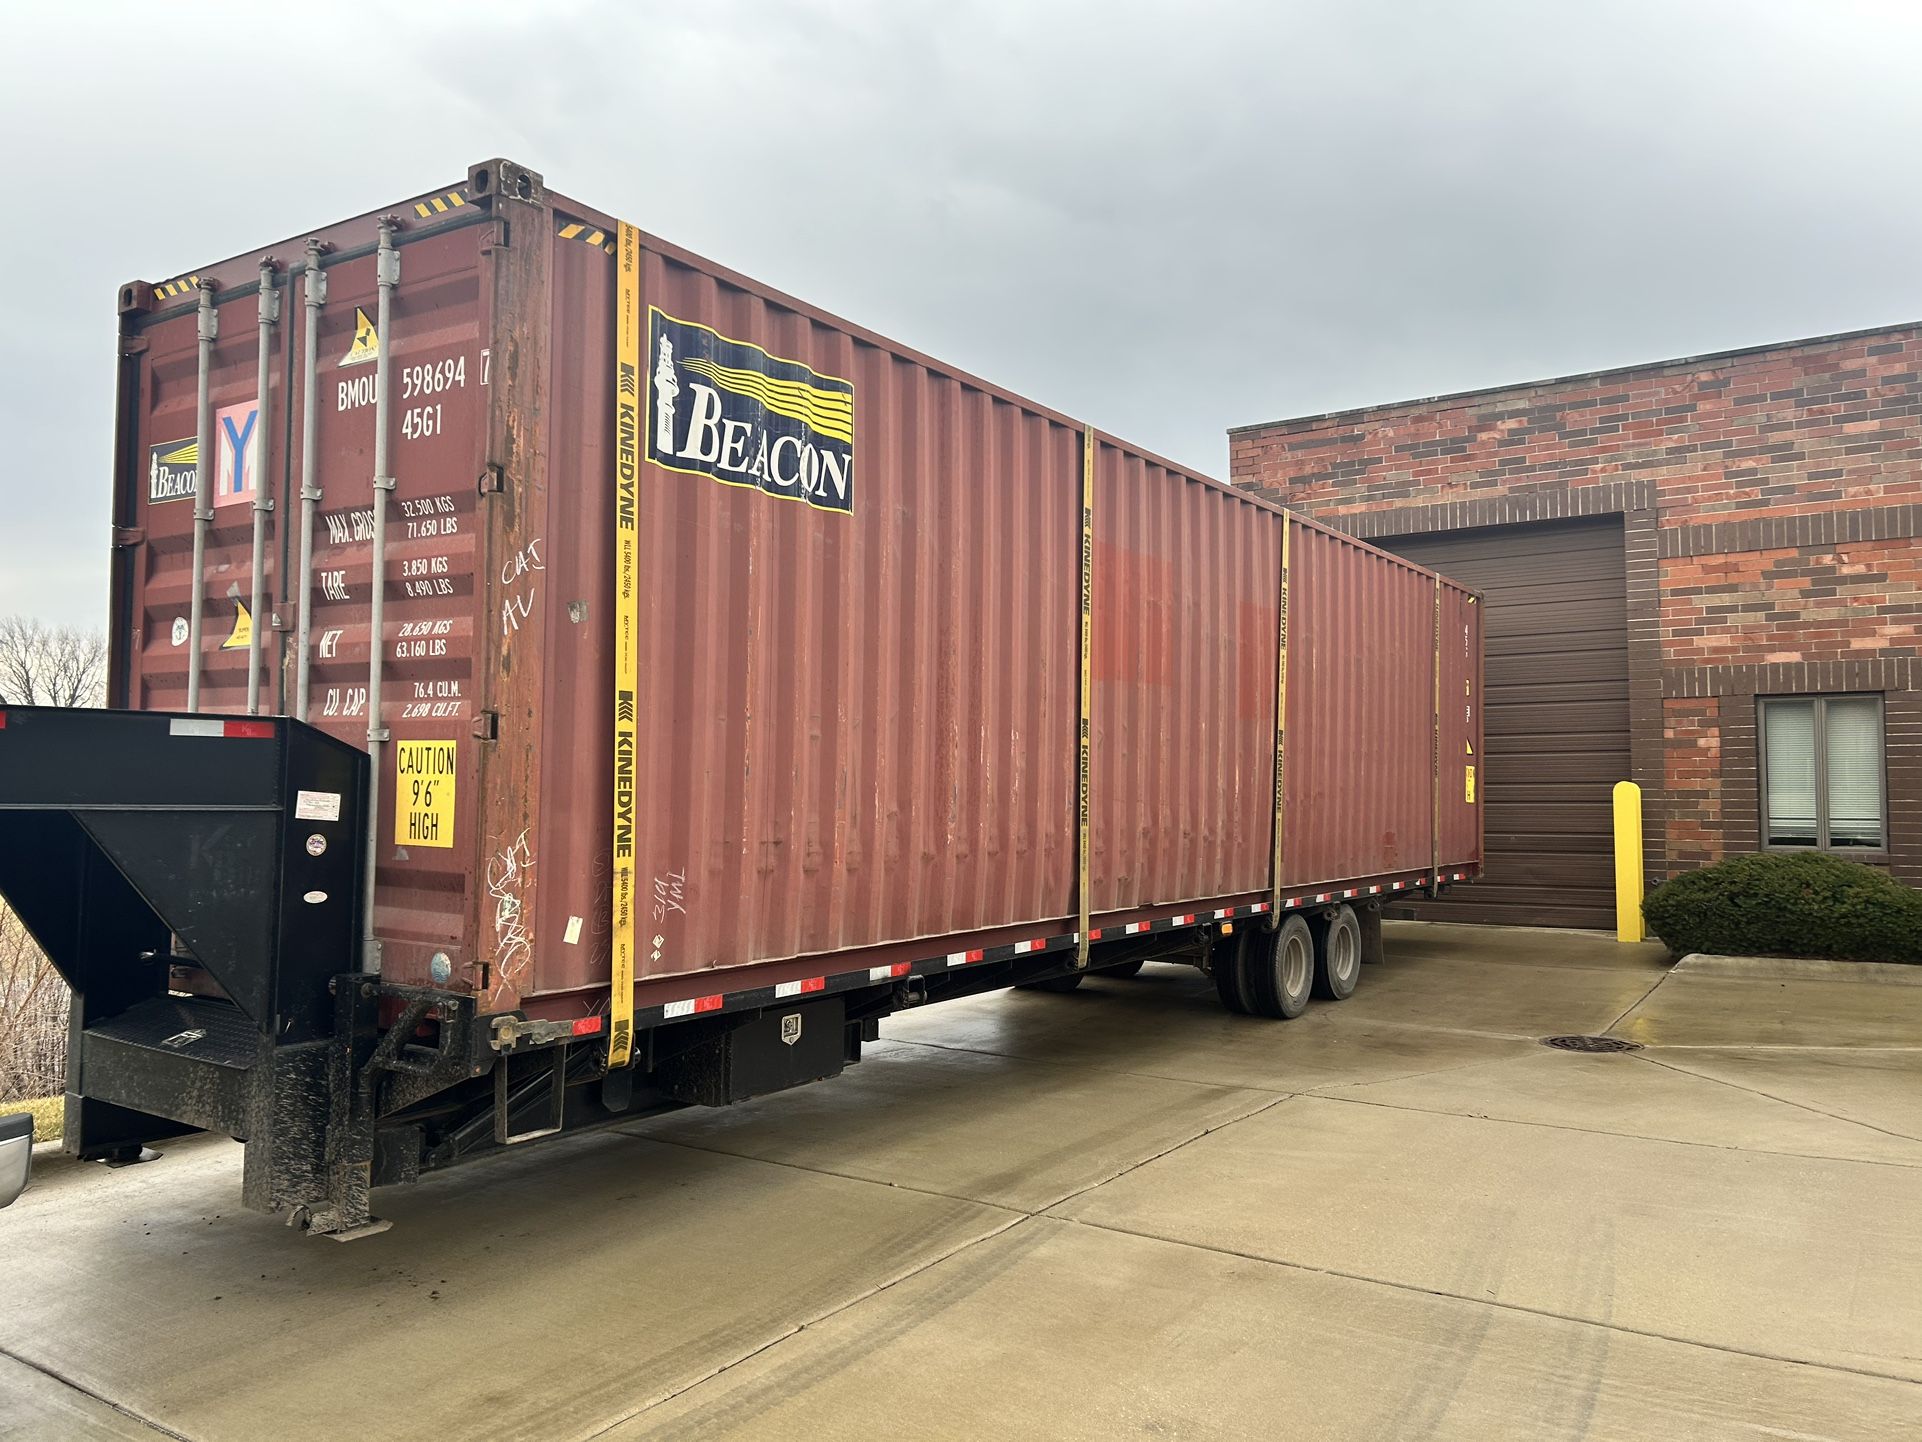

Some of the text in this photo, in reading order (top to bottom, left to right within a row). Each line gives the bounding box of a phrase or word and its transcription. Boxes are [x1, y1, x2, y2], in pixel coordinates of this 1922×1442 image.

[338, 374, 378, 412] BMOU
[402, 356, 466, 399] 598694
[402, 404, 442, 440] 45G1
[675, 382, 852, 500] BEACON
[619, 402, 634, 530] KINEDYNE
[401, 495, 455, 518] 32.500 KGS
[325, 514, 353, 544] MAX.
[407, 517, 458, 538] 71.650 LBS
[320, 557, 448, 600] TARE 3.850 KGS
[405, 578, 453, 597] 8.490 LBS
[1083, 533, 1091, 616] KINEDYNE
[1280, 588, 1288, 650] KINEDYNE
[319, 620, 453, 658] NET 28.650 KGS
[396, 639, 447, 657] 63.160 LBS
[323, 681, 461, 716] CU. CAP. 76.4 CU.M.
[402, 703, 431, 718] 2.698
[398, 747, 455, 775] CAUTION
[616, 730, 633, 858] KINEDYNE
[1081, 744, 1089, 827] KINEDYNE
[1276, 750, 1284, 813] KINEDYNE
[409, 812, 439, 840] HIGH
